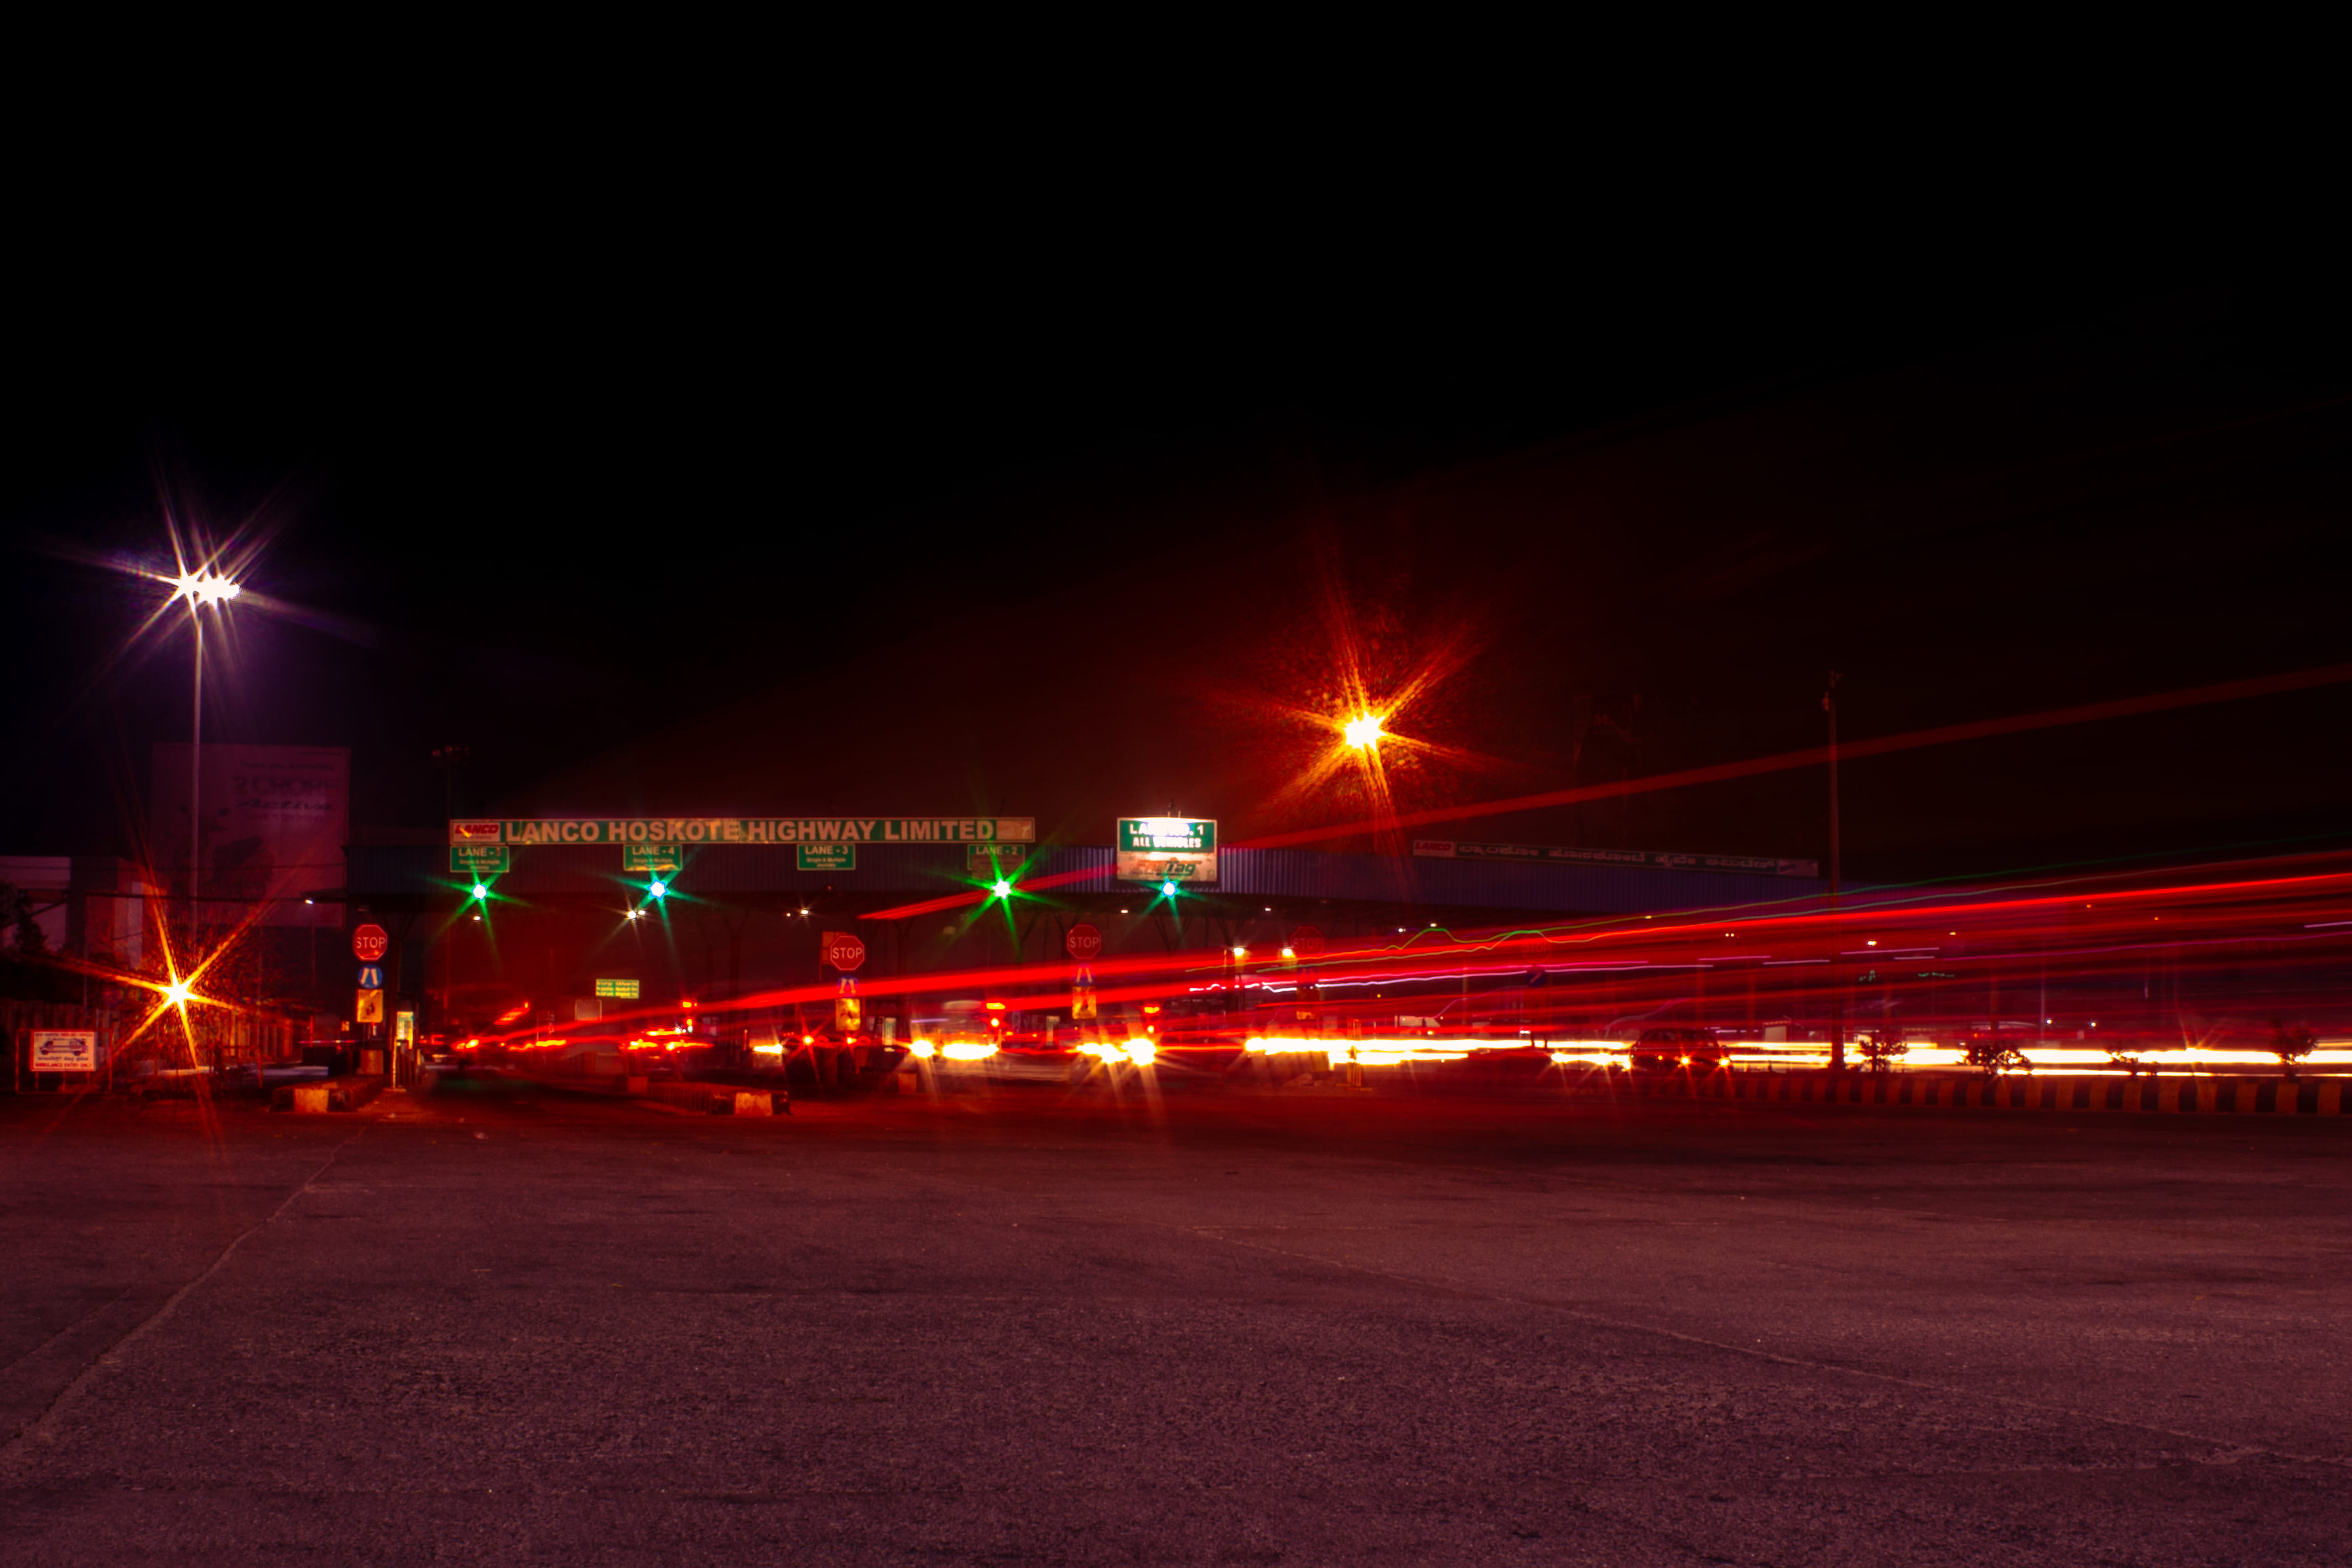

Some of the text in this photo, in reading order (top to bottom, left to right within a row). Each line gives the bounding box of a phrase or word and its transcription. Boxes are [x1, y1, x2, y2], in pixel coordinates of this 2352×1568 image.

[232, 775, 248, 794] 2
[237, 798, 334, 810] Activa
[455, 825, 499, 834] LANCO
[506, 821, 993, 841] LANCO HOSKOTE HIGHWAY LIMITED
[1130, 822, 1168, 836] LA
[1197, 825, 1204, 835] 1
[1133, 837, 1150, 847] ALL
[1415, 842, 1451, 851] LANCO
[459, 847, 487, 857] LANE
[632, 846, 659, 855] LANE
[668, 846, 674, 855] 4
[805, 846, 834, 855] LANE
[842, 846, 848, 855] 3
[976, 846, 1002, 855] LANE
[1012, 846, 1018, 855] 2
[356, 937, 386, 948] STOP
[1069, 936, 1099, 948] STOP
[1293, 938, 1321, 949] STOP
[831, 946, 862, 960] STOP
